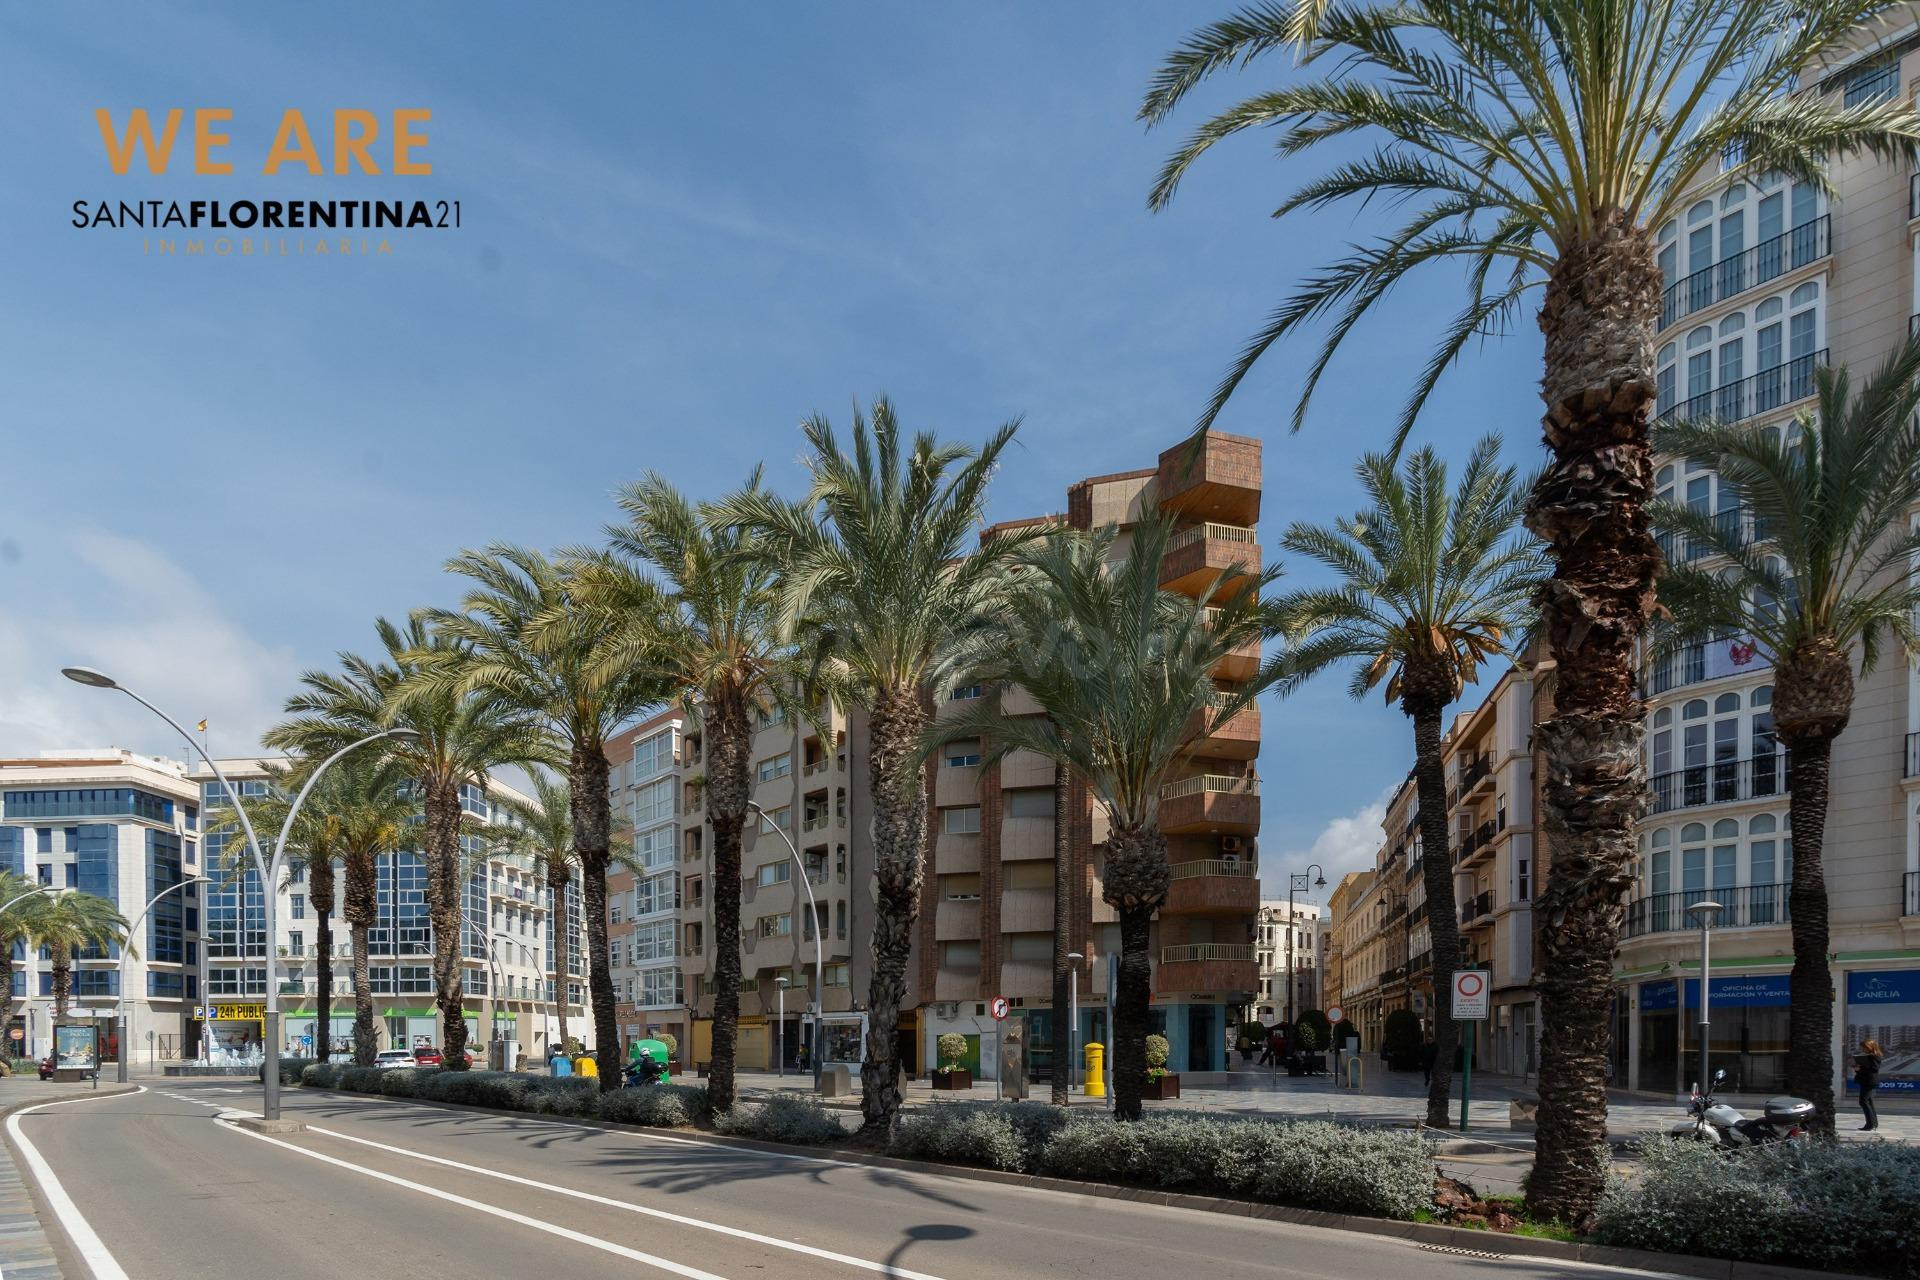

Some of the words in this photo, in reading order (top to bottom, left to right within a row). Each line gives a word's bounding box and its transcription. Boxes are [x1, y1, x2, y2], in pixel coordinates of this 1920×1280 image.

[1722, 984, 1754, 992] OFICINA
[1708, 990, 1756, 999] FORMACIÓN
[1856, 990, 1901, 999] CANELIA
[219, 1006, 235, 1018] 24h
[237, 1006, 267, 1018] PUBLIC
